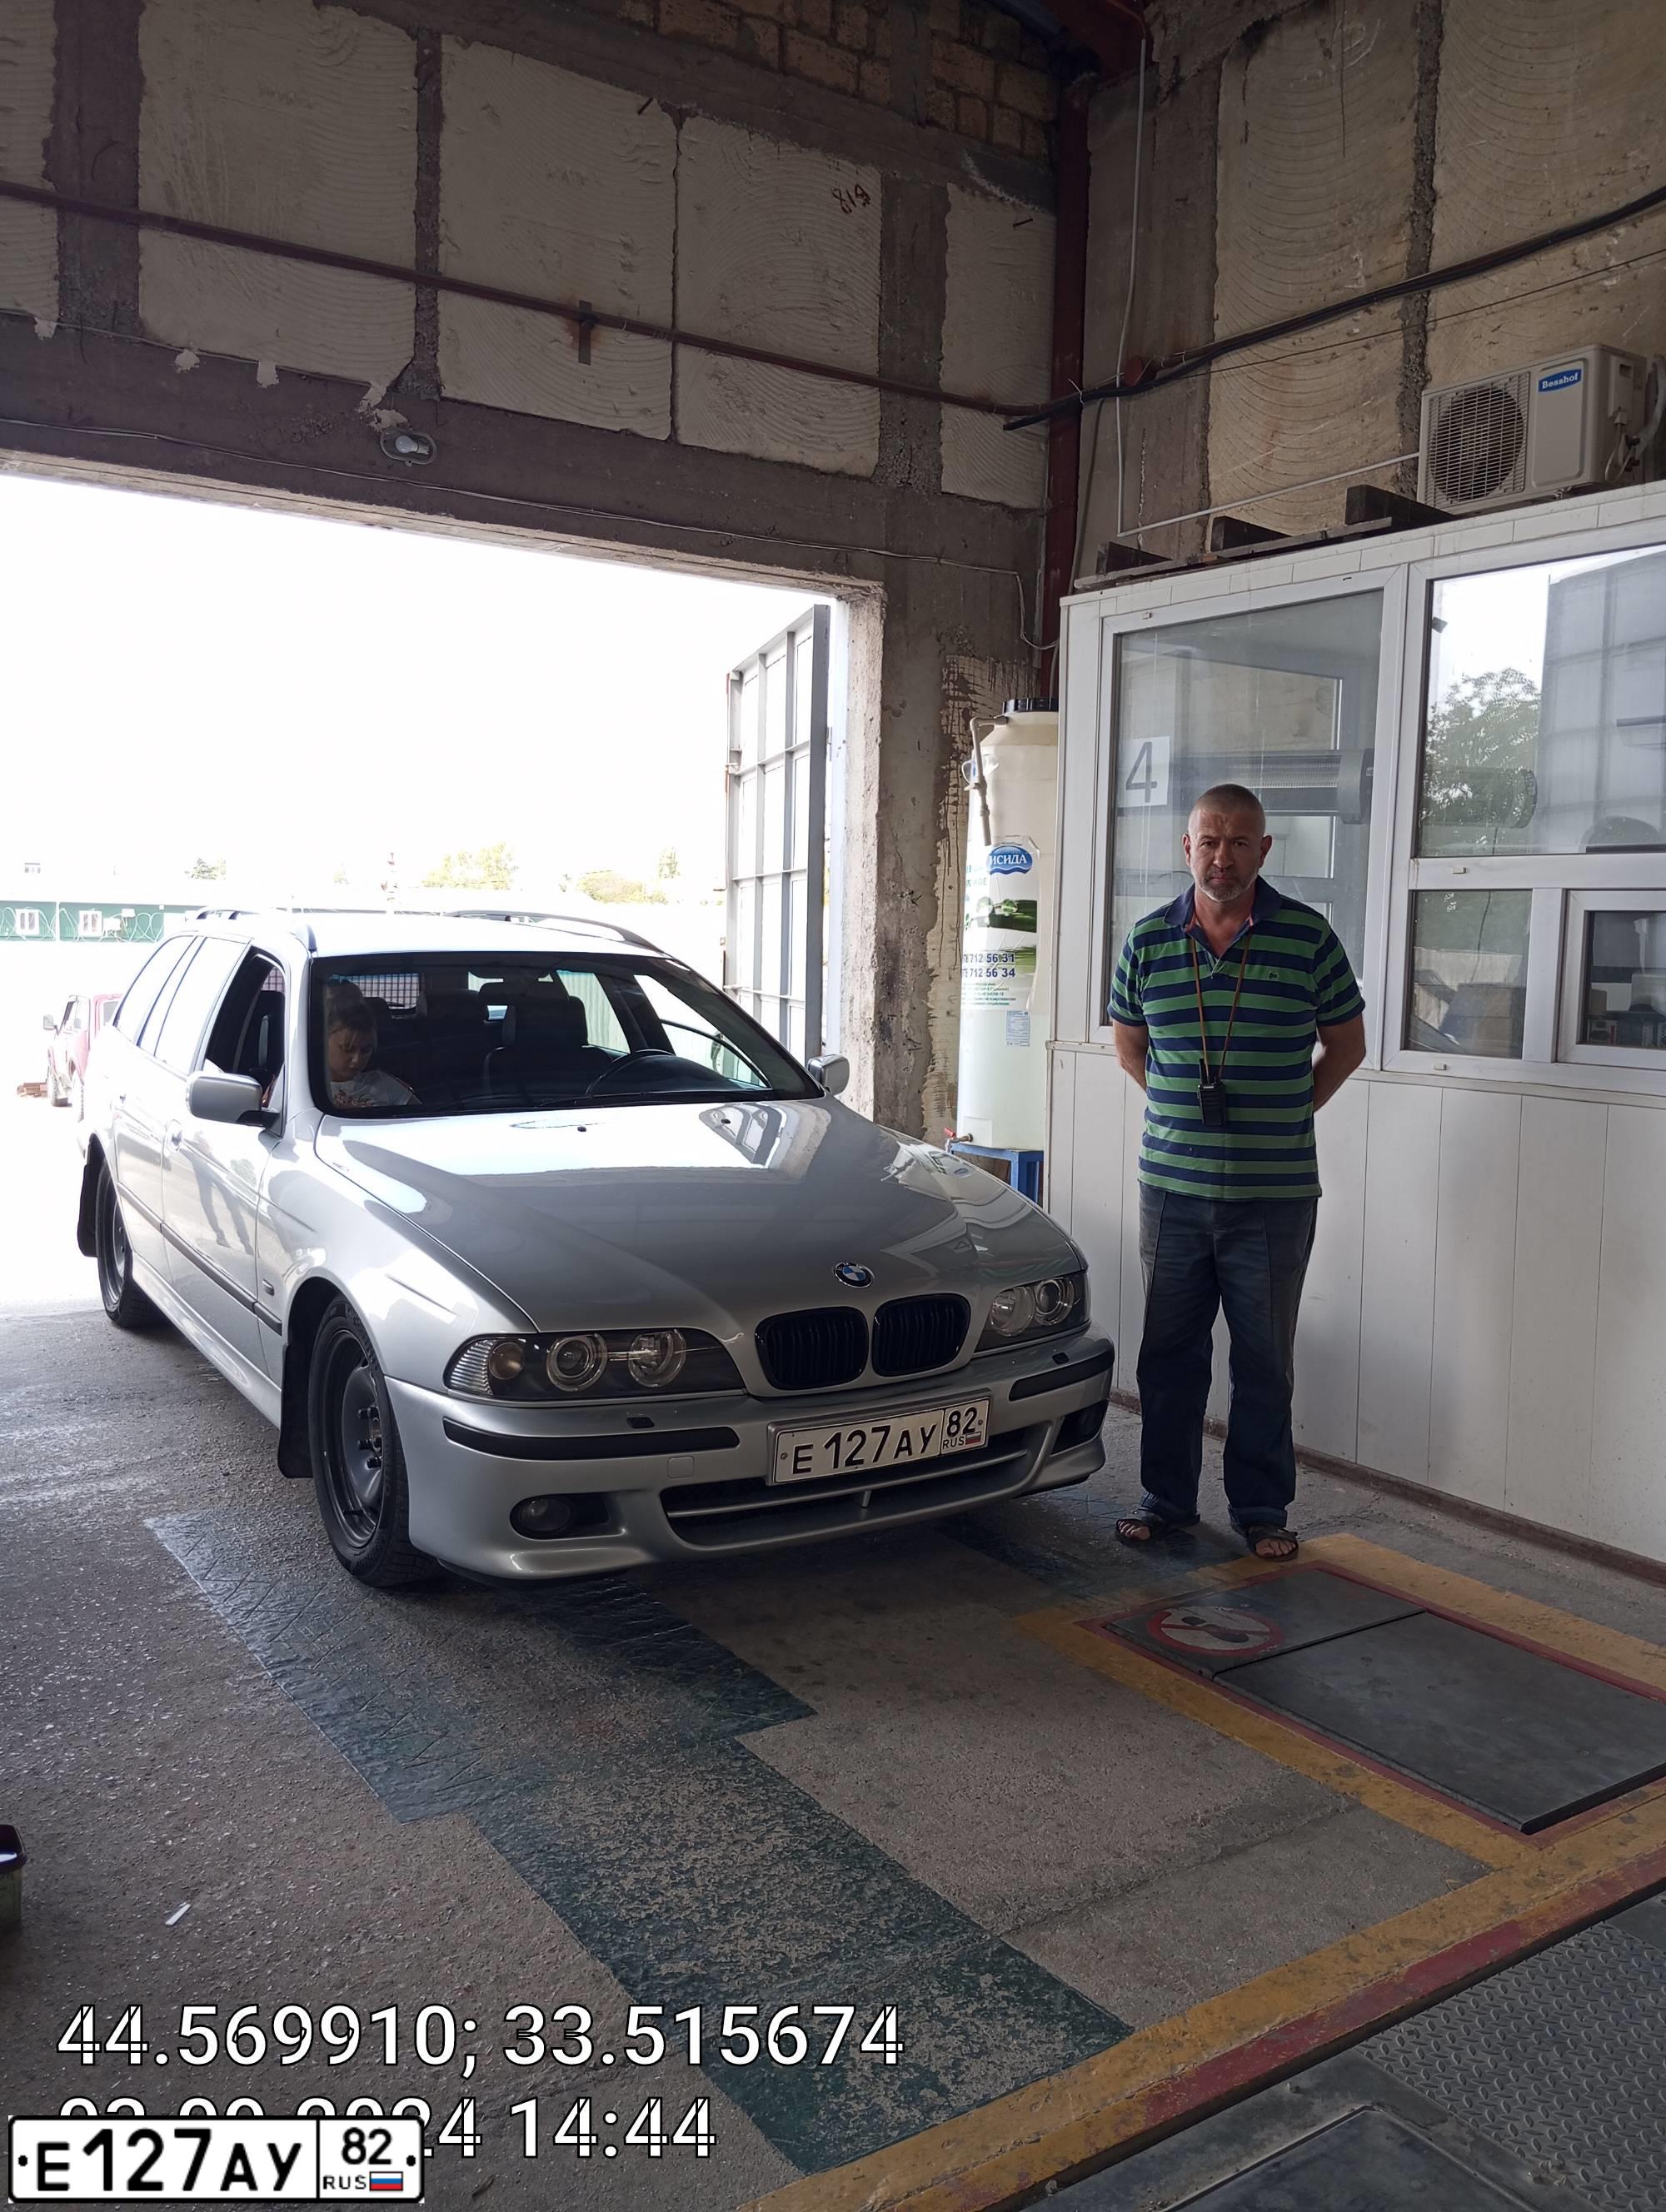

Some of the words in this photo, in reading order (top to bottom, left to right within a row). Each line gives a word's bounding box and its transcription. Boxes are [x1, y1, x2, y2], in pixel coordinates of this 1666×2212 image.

[1126, 741, 1158, 803] 4
[986, 953, 998, 963] 56
[986, 968, 998, 977] 56
[1001, 968, 1015, 977] 34
[946, 1407, 977, 1437] 82
[942, 1436, 965, 1450] RUS
